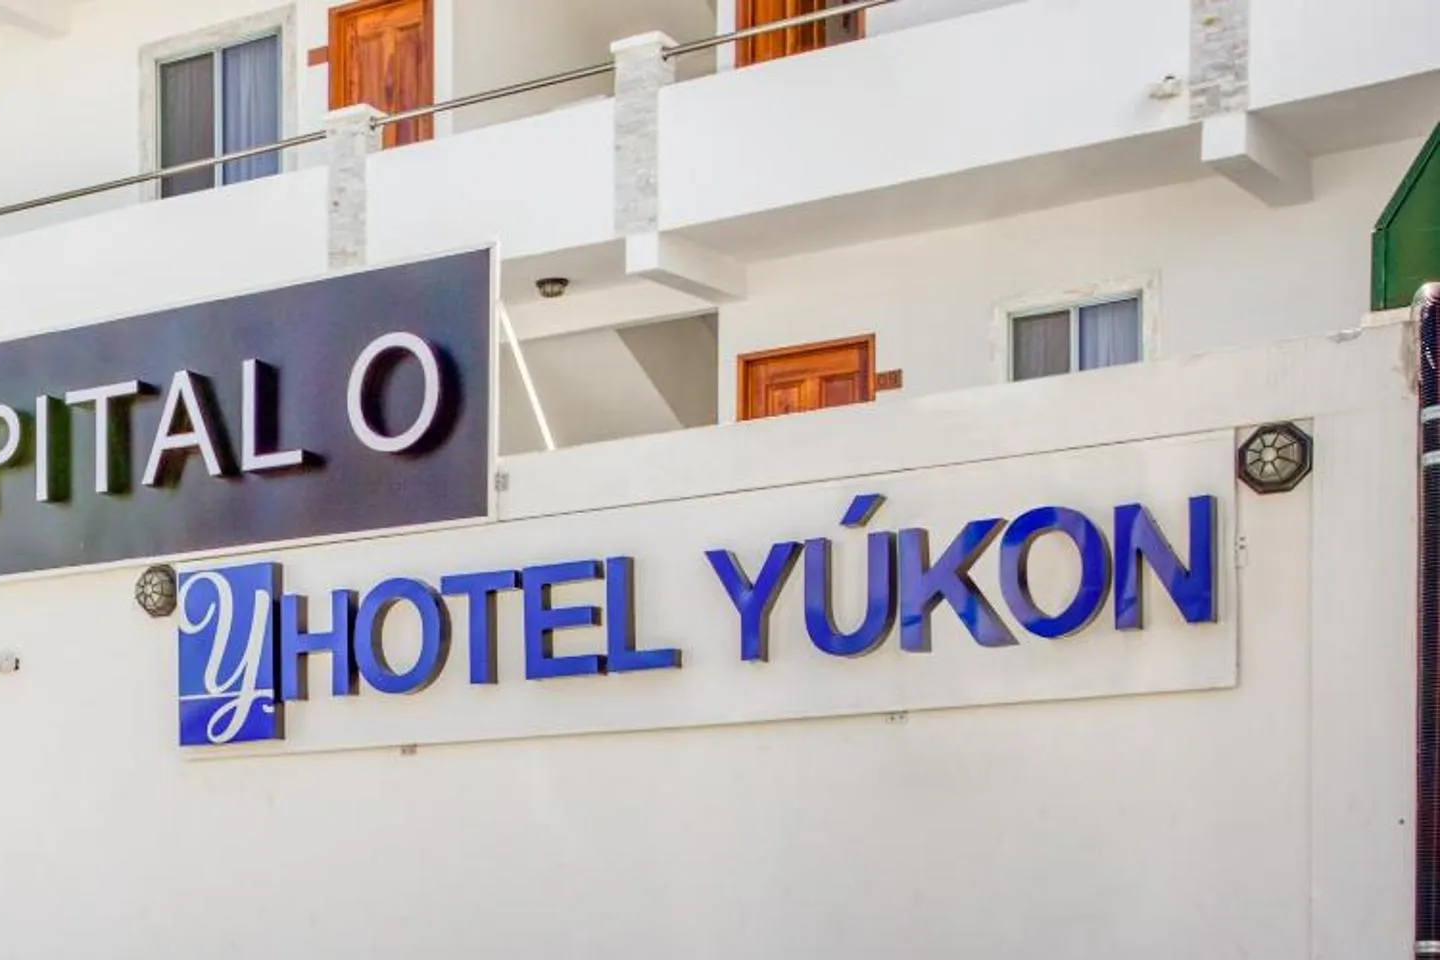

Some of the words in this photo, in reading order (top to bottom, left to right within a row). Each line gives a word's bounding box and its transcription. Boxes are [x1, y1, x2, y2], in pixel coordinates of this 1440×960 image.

[347, 331, 443, 454] O
[281, 554, 682, 701] HOTEL
[704, 493, 1217, 663] YÚKON
